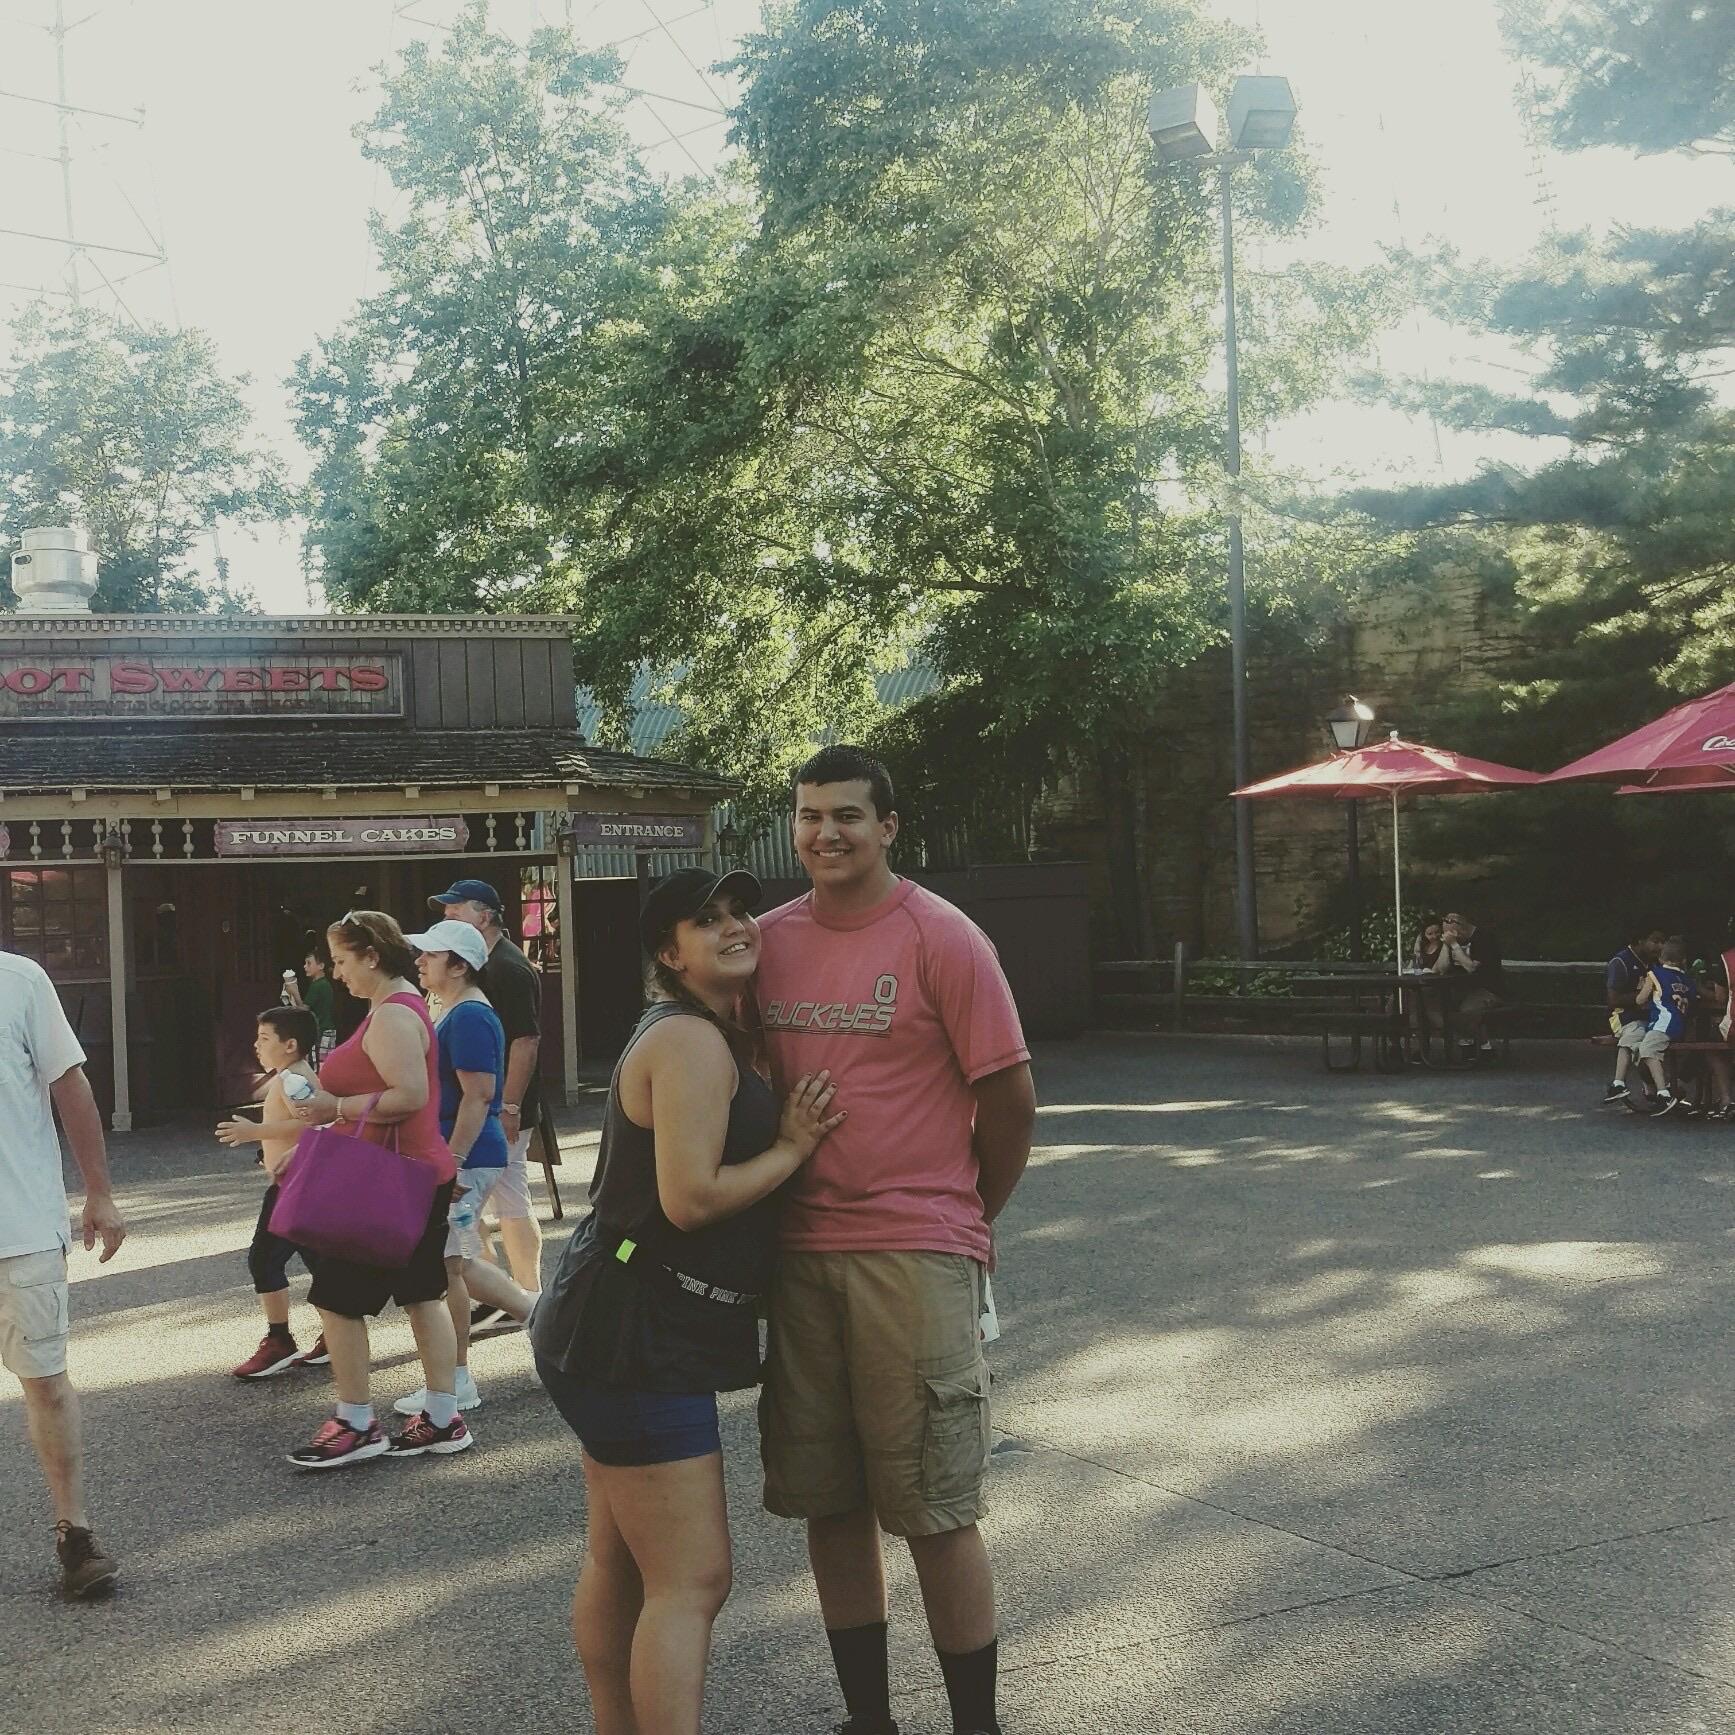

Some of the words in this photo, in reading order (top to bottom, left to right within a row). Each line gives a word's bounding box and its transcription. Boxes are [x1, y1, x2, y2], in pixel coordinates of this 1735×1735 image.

[0, 667, 95, 695] OT
[110, 662, 389, 695] SWEETS
[230, 830, 352, 844] FUNNEL
[360, 827, 457, 842] CAKES
[600, 823, 684, 838] ENTRANCE
[765, 1000, 897, 1032] BUCKEYES
[676, 1272, 708, 1296] PINK
